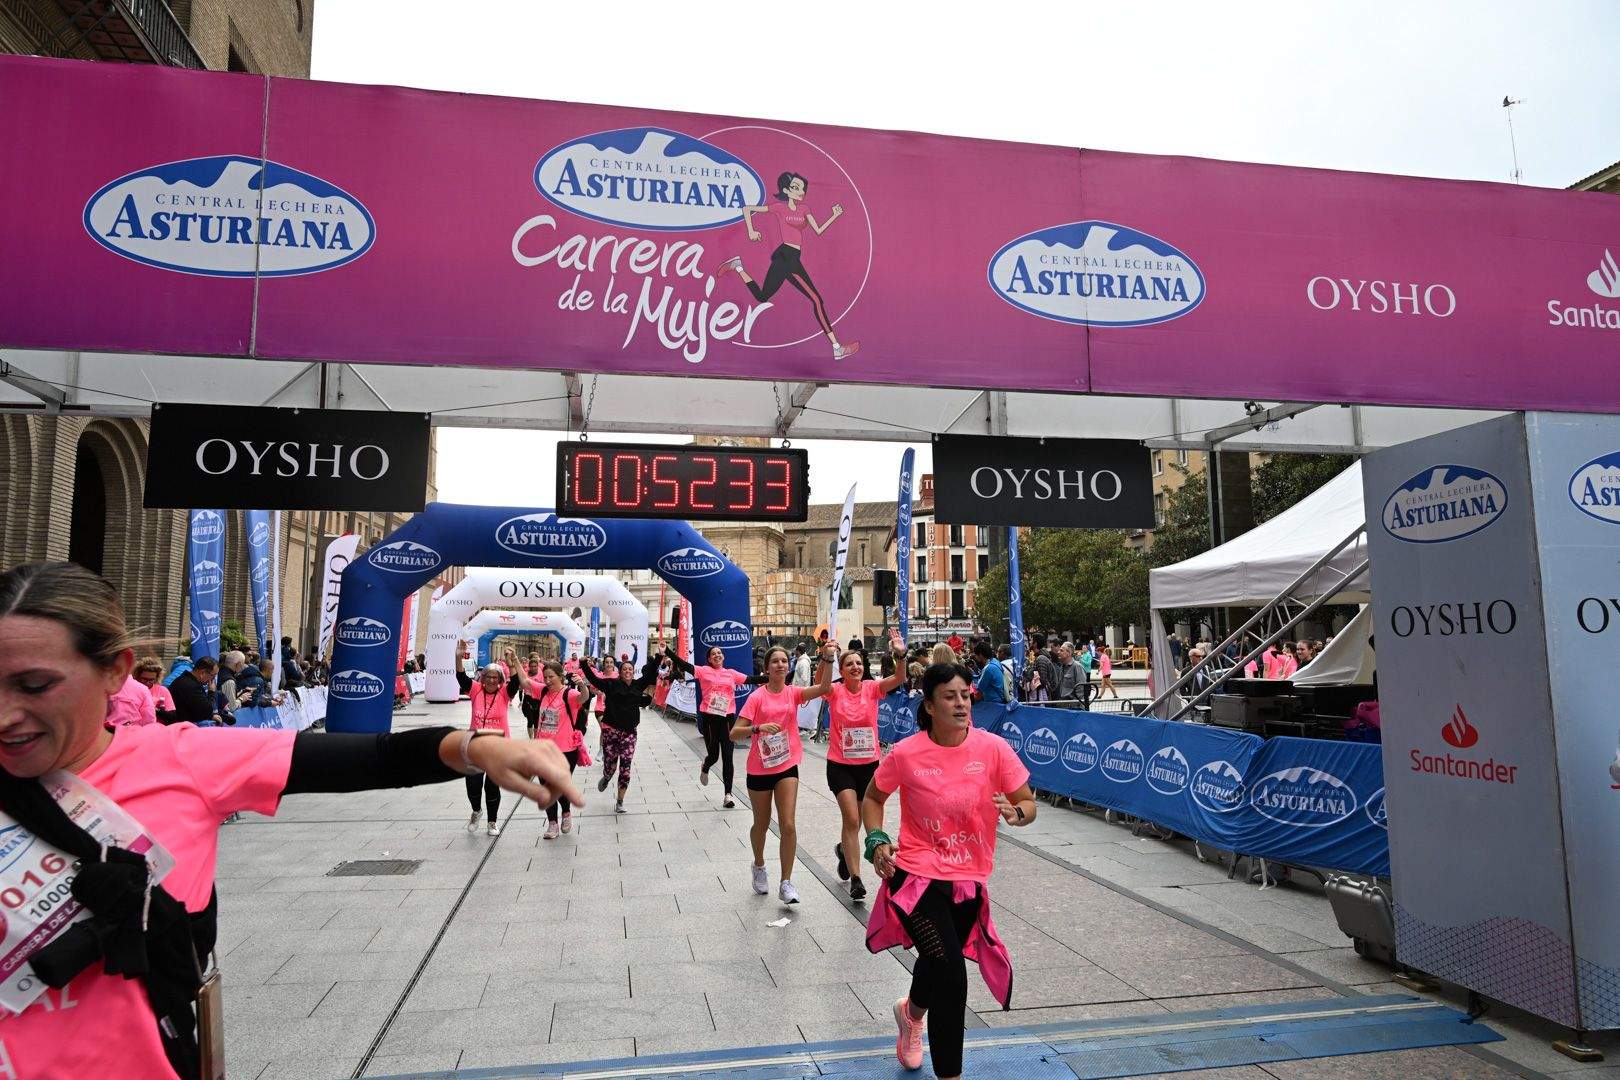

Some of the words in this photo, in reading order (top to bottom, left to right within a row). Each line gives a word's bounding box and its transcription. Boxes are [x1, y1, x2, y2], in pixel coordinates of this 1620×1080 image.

[552, 158, 746, 209] ASTURIANA
[590, 158, 662, 172] CENTRAL
[670, 165, 741, 179] LECHERA
[155, 193, 245, 209] CENTRAL
[255, 199, 346, 215] LECHERA
[106, 194, 353, 251] ASTURIANA
[511, 214, 706, 279] Carrera
[1039, 254, 1107, 268] CENTRAL
[1115, 258, 1182, 272] LECHERA
[1006, 255, 1190, 303] ASTURIANA
[558, 275, 594, 311] de
[602, 275, 628, 314] la
[1307, 276, 1456, 318] OYSHO
[623, 275, 774, 363] Mujer
[195, 438, 390, 480] OYSHO
[970, 466, 1122, 501] OYSHO
[1406, 492, 1443, 506] CENTRAL
[1448, 483, 1491, 497] LECHERA
[1390, 494, 1498, 530] ASTURIANA
[505, 525, 598, 547] ASTURIANA
[373, 551, 435, 566] ASTURIANA
[663, 557, 720, 571] ASTURIANA
[499, 581, 585, 598] OYSHO
[337, 626, 387, 640] ASTURIANA
[1391, 600, 1517, 637] OYSHO
[1027, 739, 1056, 757] ASTURIANA
[1063, 746, 1095, 766] ASTURIANA
[1103, 753, 1139, 774] ASTURIANA
[1147, 760, 1185, 787] ASTURIANA
[1410, 749, 1517, 785] Santander
[1255, 785, 1347, 815] ASTURIANA
[2, 927, 50, 972] CARRERA
[48, 911, 67, 930] DE
[65, 900, 82, 918] LA
